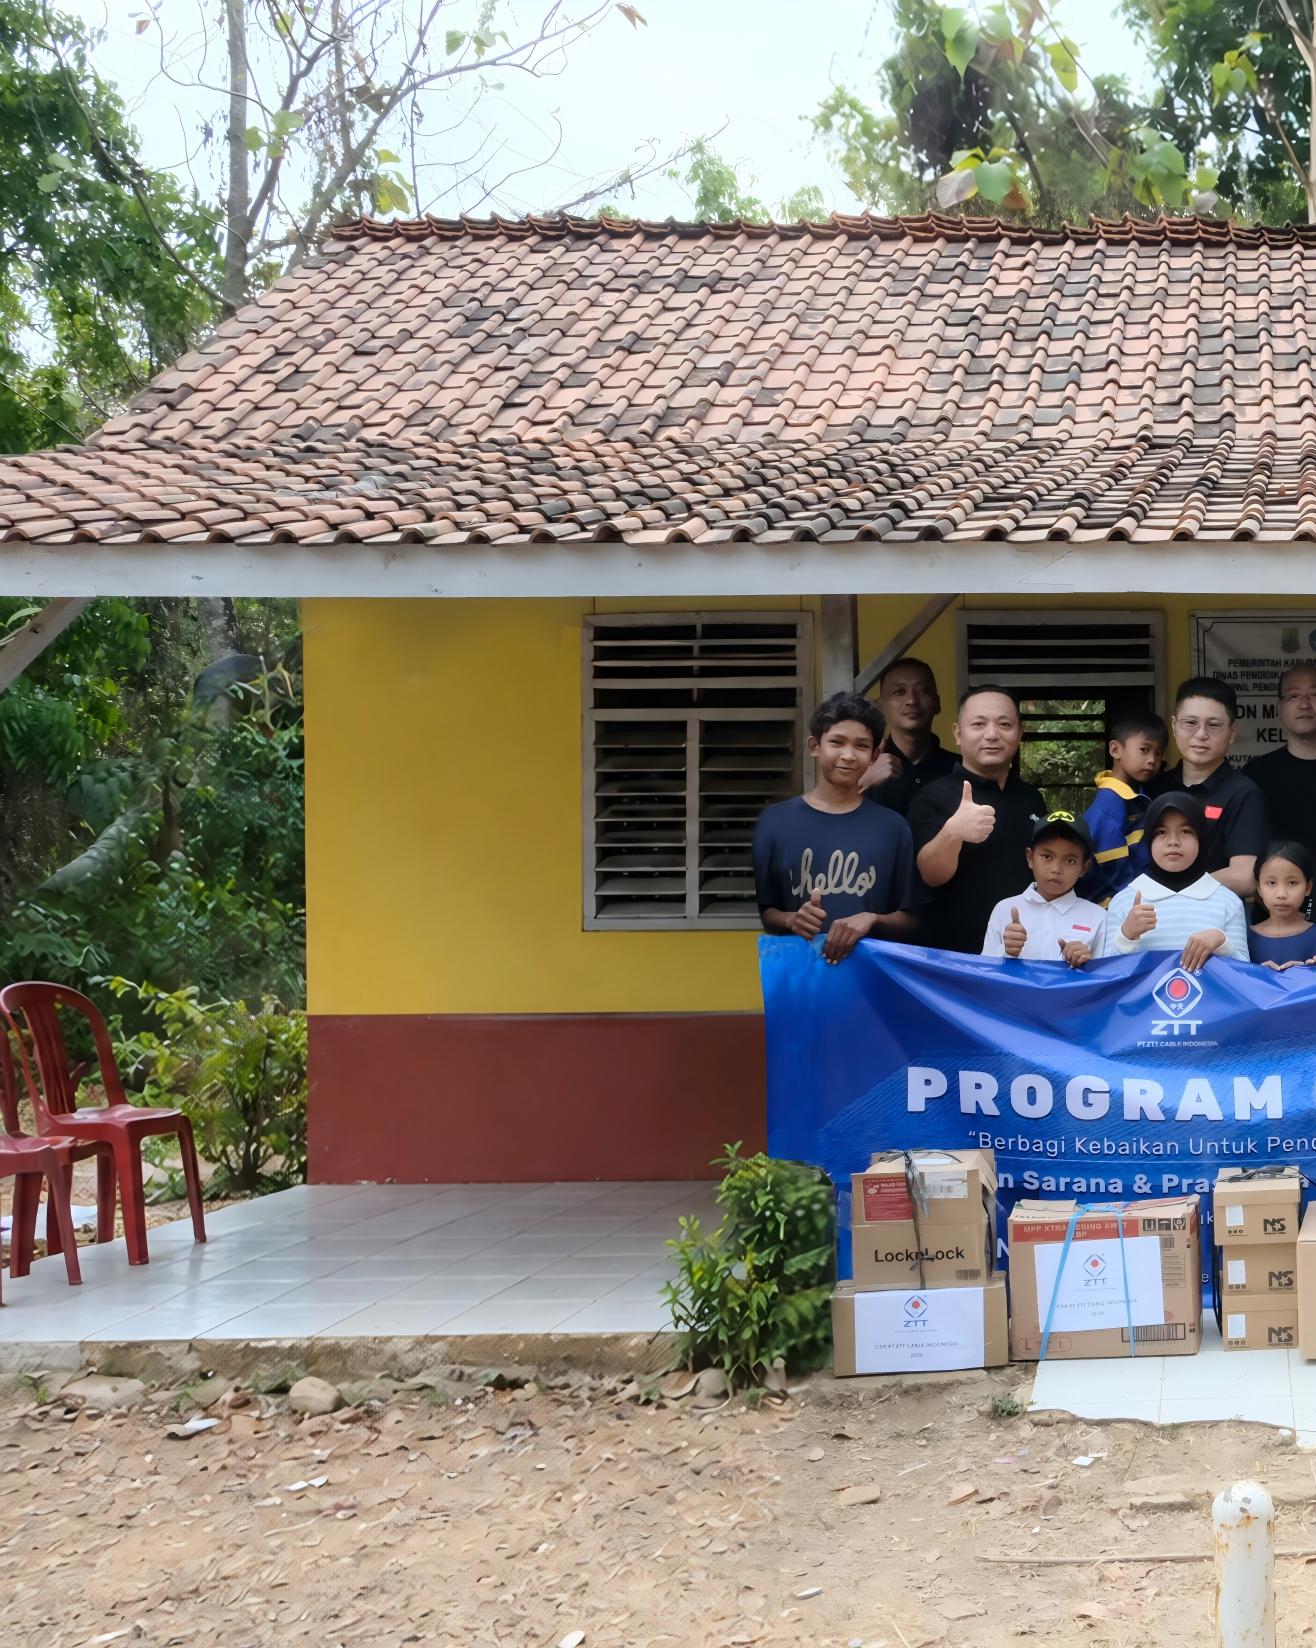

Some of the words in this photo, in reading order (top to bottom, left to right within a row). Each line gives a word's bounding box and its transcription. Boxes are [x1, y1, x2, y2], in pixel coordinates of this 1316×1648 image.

[1228, 659, 1281, 667] PEMERINTAH
[1213, 671, 1238, 679] DINAS
[1241, 671, 1286, 679] PENDIDIKA
[791, 848, 877, 898] hello
[1151, 1020, 1203, 1036] ZTT
[907, 1066, 1284, 1121] PROGRAM
[1075, 1136, 1180, 1155] Kebaikan
[1189, 1135, 1258, 1155] Untuk
[1023, 1170, 1124, 1194] Sarana
[1132, 1173, 1153, 1194] &
[1105, 1221, 1128, 1230] AWT
[874, 1246, 966, 1263] LocknLock
[1083, 1278, 1108, 1287] ZTT
[904, 1320, 929, 1328] ZTT
